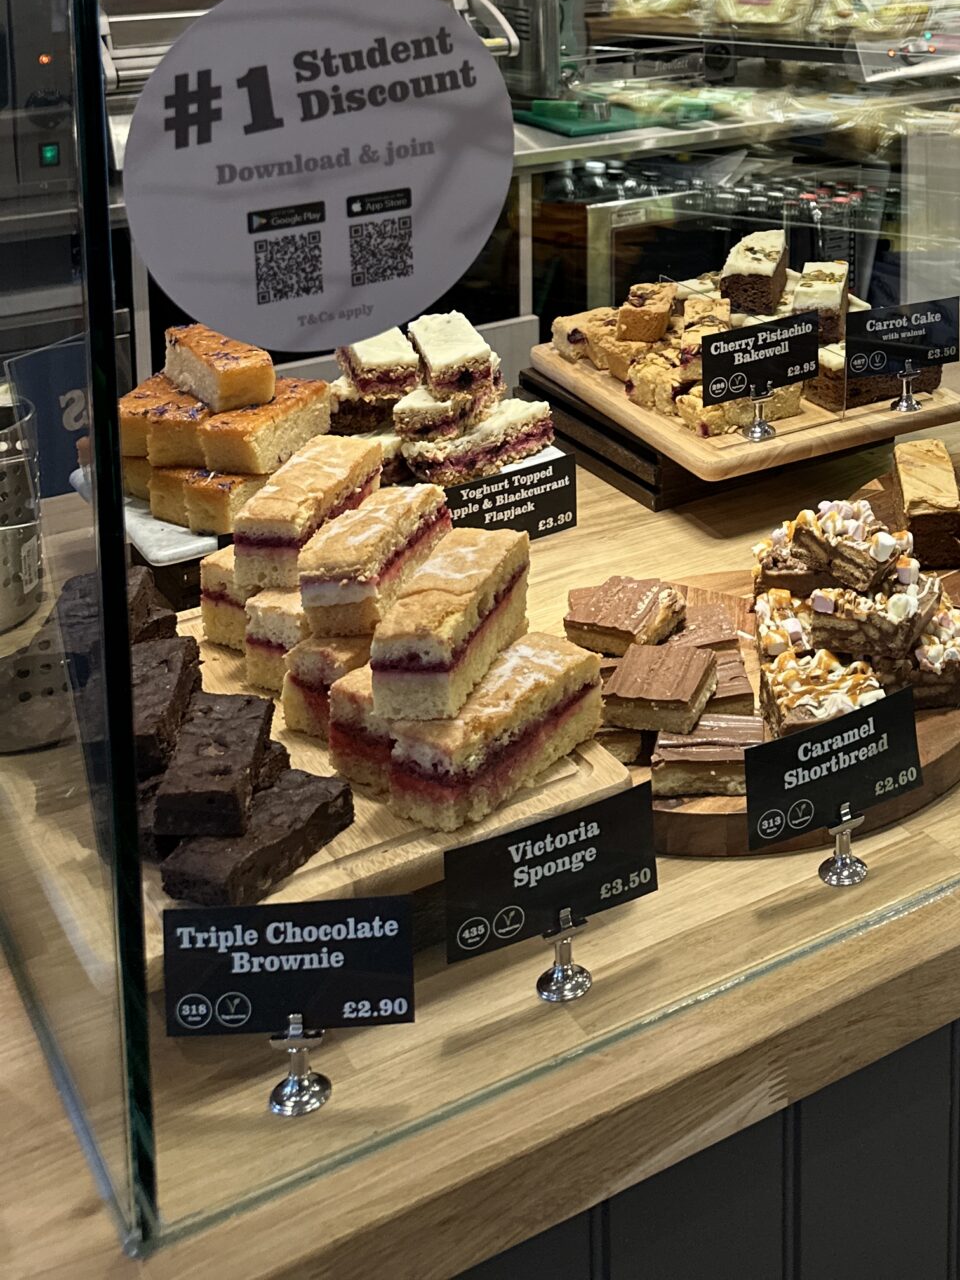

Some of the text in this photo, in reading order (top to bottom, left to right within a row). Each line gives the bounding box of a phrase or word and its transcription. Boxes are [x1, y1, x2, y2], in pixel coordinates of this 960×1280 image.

[293, 27, 453, 83] Student
[297, 59, 477, 121] Discount
[164, 65, 284, 149] #1
[216, 137, 435, 185] Download & join
[366, 198, 407, 211] App Store
[271, 216, 300, 226] Google
[303, 212, 321, 222] Play
[297, 303, 373, 327] T&Cs apply
[866, 312, 941, 331] Carrot Cake
[710, 322, 812, 355] Cherry Pistachio
[882, 328, 926, 340] with walnut
[734, 341, 789, 365] Bakewell
[928, 346, 956, 359] £3.50
[787, 361, 816, 377] £2.95
[460, 466, 553, 500] Yoghurt Topped
[482, 499, 492, 509] &
[496, 475, 569, 506] Blackcurrant
[485, 502, 535, 523] Flapjack
[538, 512, 573, 530] £3.30
[798, 717, 875, 761] Caramel
[784, 733, 888, 790] Shortbread
[875, 767, 917, 796] £2.60
[762, 817, 781, 829] 313
[508, 822, 600, 863] Victoria
[514, 847, 597, 887] Sponge
[600, 868, 651, 899] £3.50
[177, 916, 399, 952] Triple Chocolate
[462, 925, 485, 938] 435
[231, 947, 344, 973] Brownie
[182, 1004, 206, 1015] 318
[343, 998, 408, 1018] £2.90
